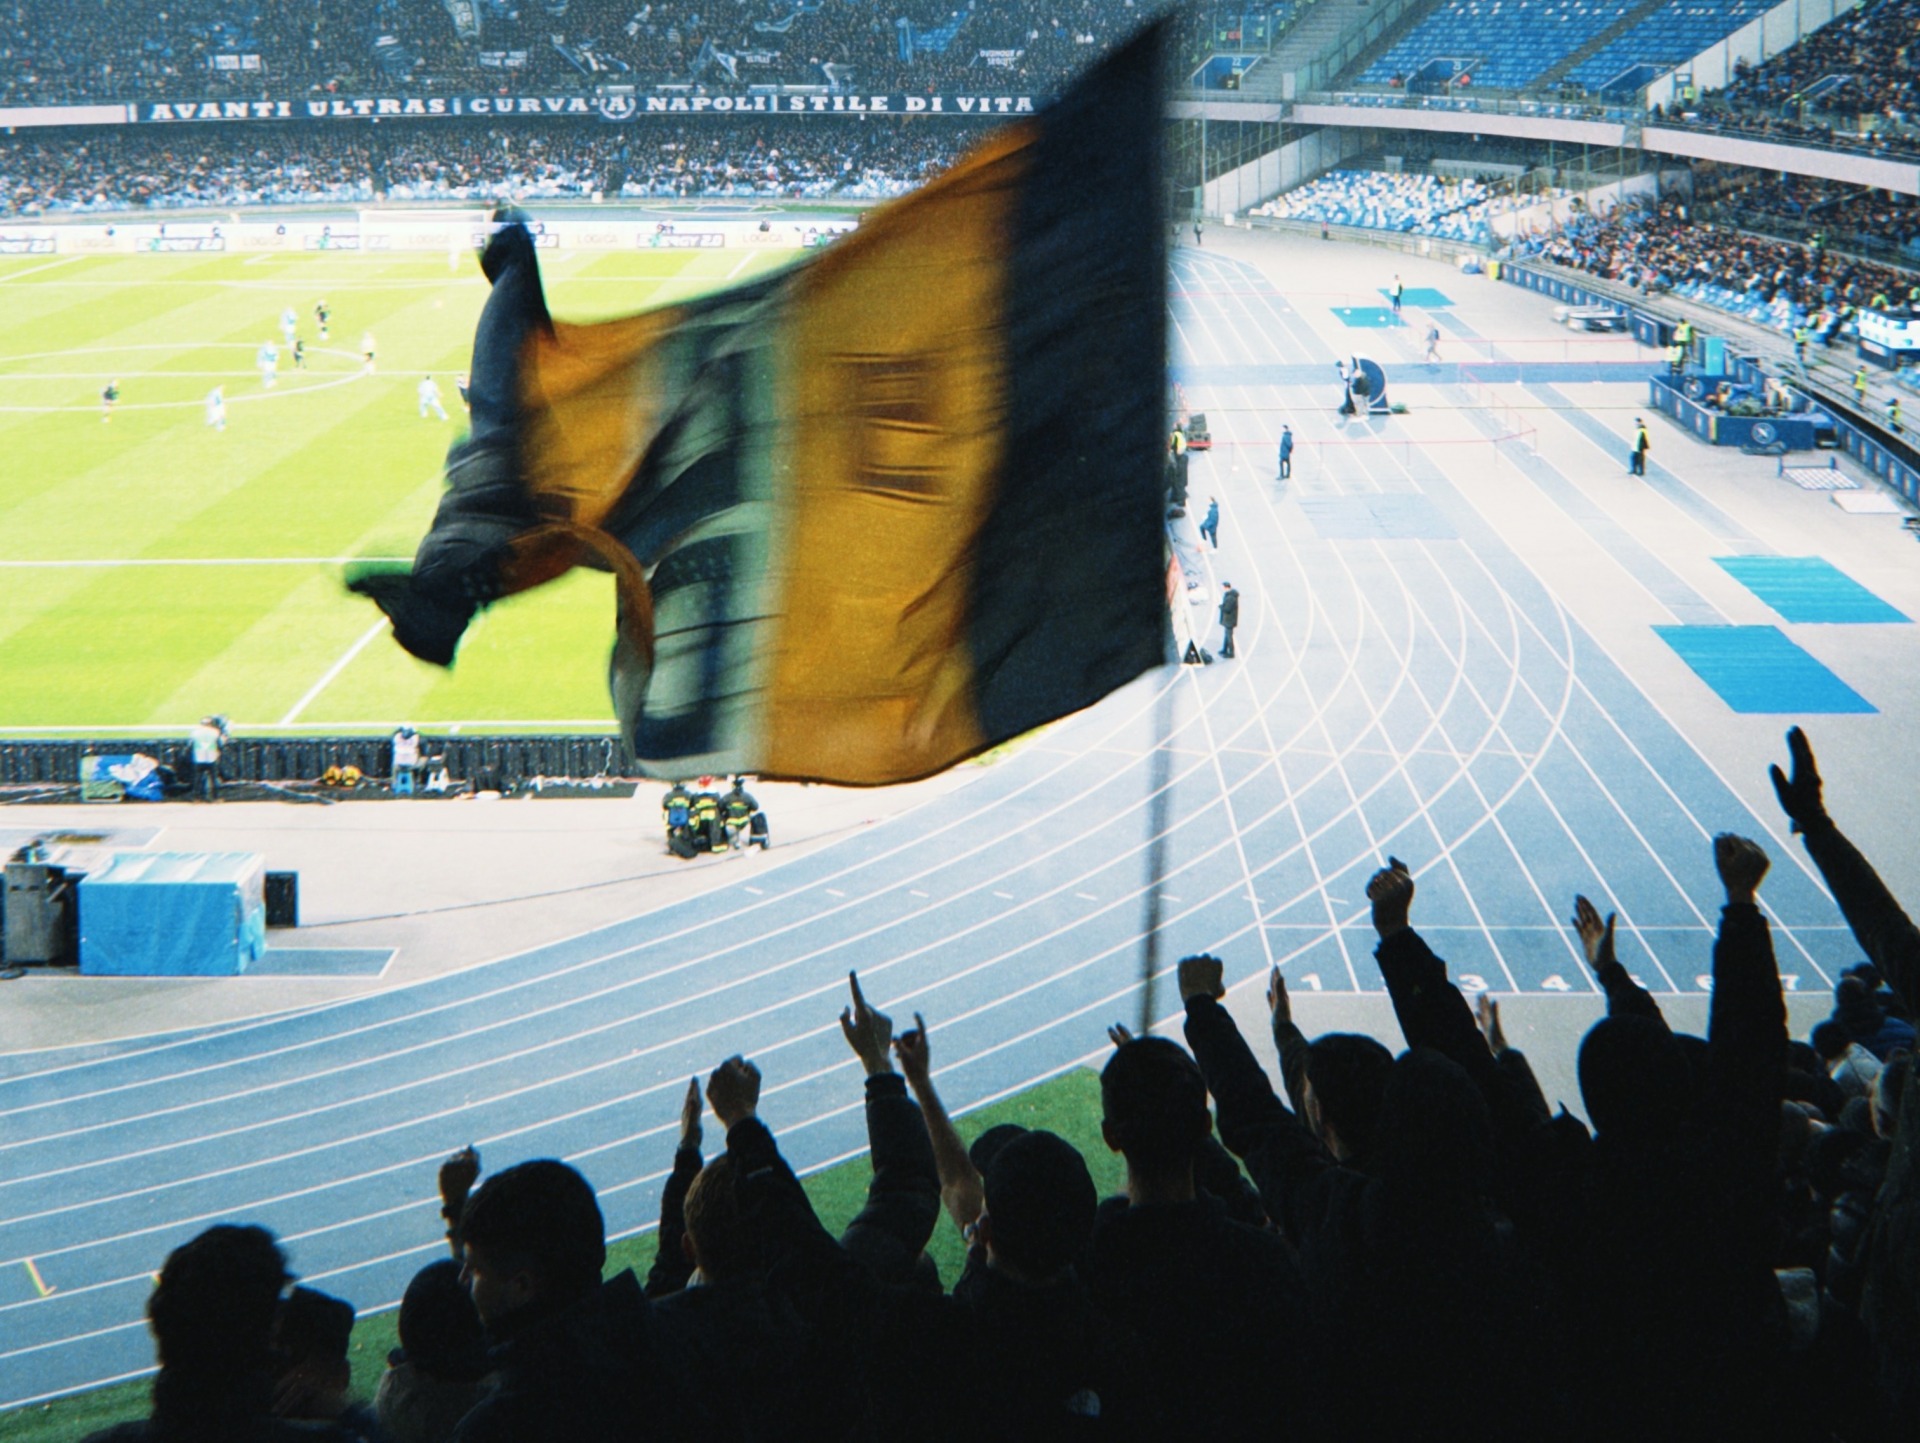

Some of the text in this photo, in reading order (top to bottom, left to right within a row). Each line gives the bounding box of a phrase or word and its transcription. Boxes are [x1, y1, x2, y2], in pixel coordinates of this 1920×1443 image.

[151, 102, 291, 120] AVANTI
[308, 98, 446, 116] ULTRAS
[469, 97, 588, 113] CURVA
[646, 96, 766, 111] NAPOLI
[790, 96, 1035, 112] STILE DI VITA
[1301, 973, 1323, 990] 1
[1459, 974, 1488, 991] 3
[1541, 974, 1571, 991] 4
